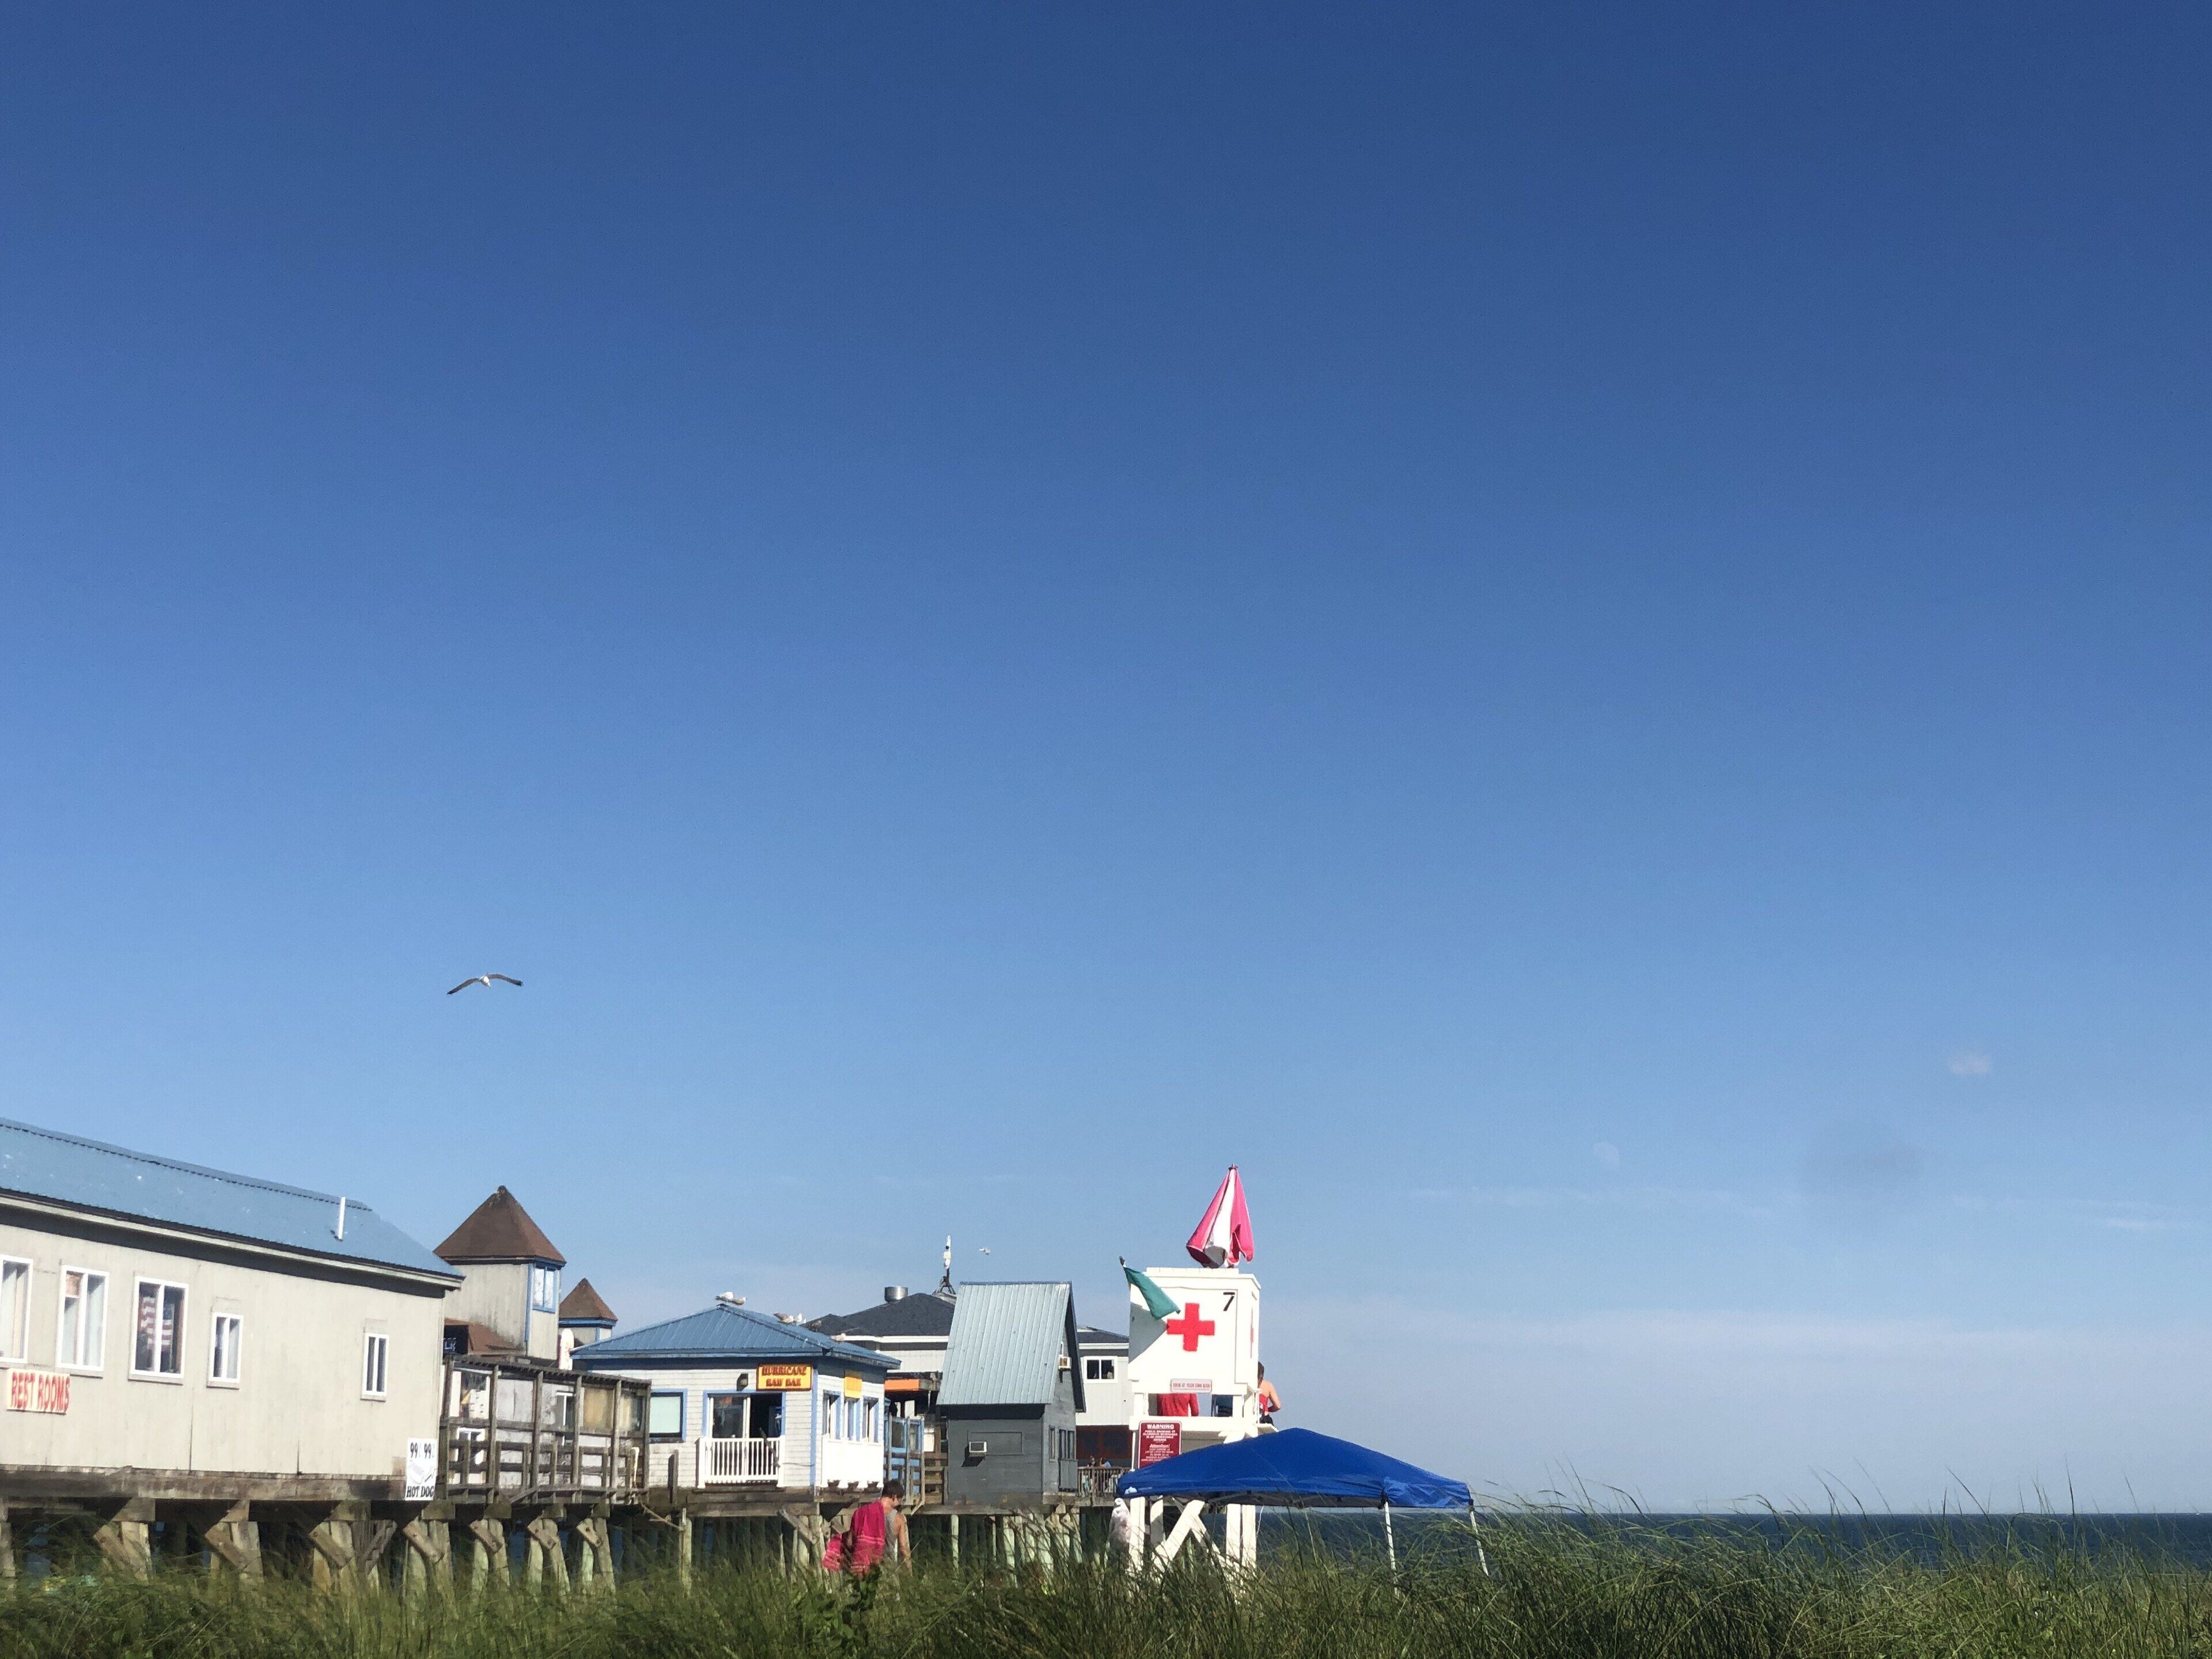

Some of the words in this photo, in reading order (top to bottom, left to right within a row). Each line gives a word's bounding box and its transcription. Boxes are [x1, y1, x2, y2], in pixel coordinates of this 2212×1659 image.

[1223, 1291, 1235, 1312] 7
[762, 1366, 807, 1376] HURRICANE
[766, 1378, 783, 1387] RAW
[785, 1378, 801, 1387] BAR
[11, 1372, 35, 1410] REST
[37, 1374, 70, 1412] ROOMS
[406, 1486, 420, 1498] HOT
[421, 1486, 434, 1498] DOG
